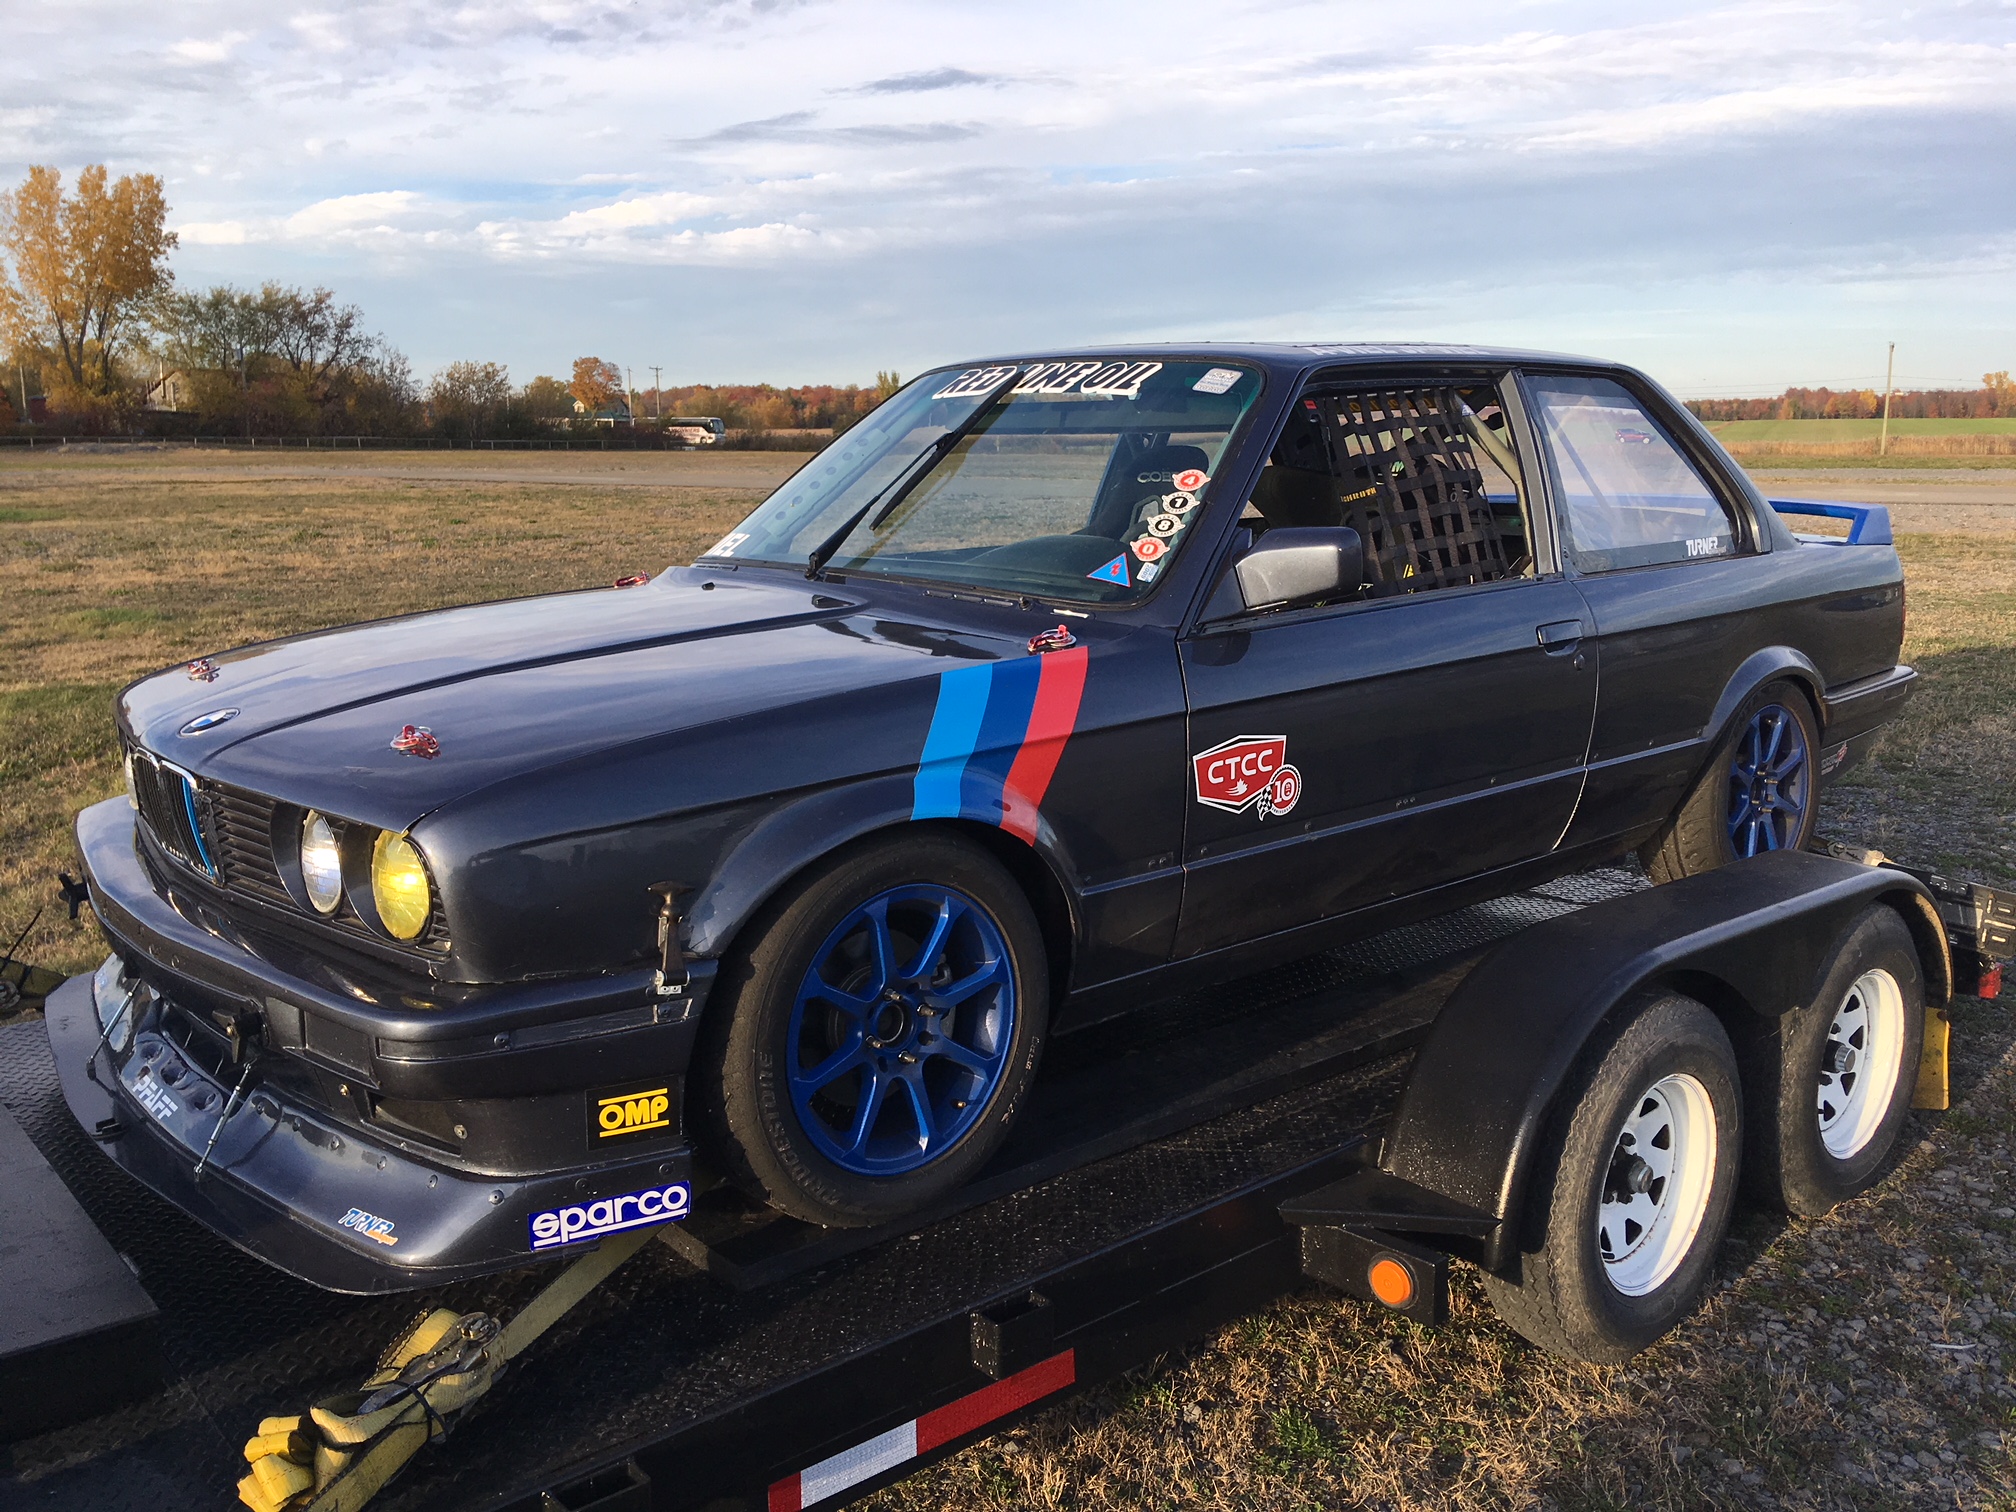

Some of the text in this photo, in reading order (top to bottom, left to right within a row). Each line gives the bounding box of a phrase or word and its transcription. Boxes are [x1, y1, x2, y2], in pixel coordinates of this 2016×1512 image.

[932, 362, 1162, 399] RED LINE OIL
[1137, 471, 1179, 483] COB
[1157, 519, 1172, 531] 8
[1141, 543, 1155, 555] 0
[1686, 536, 1718, 557] TURNER
[1207, 748, 1273, 784] CTCC
[1273, 777, 1295, 804] 10
[132, 1075, 178, 1120] PFAFF
[598, 1095, 669, 1130] OMP
[338, 1207, 395, 1235] TURNER
[531, 1185, 688, 1244] sparco
